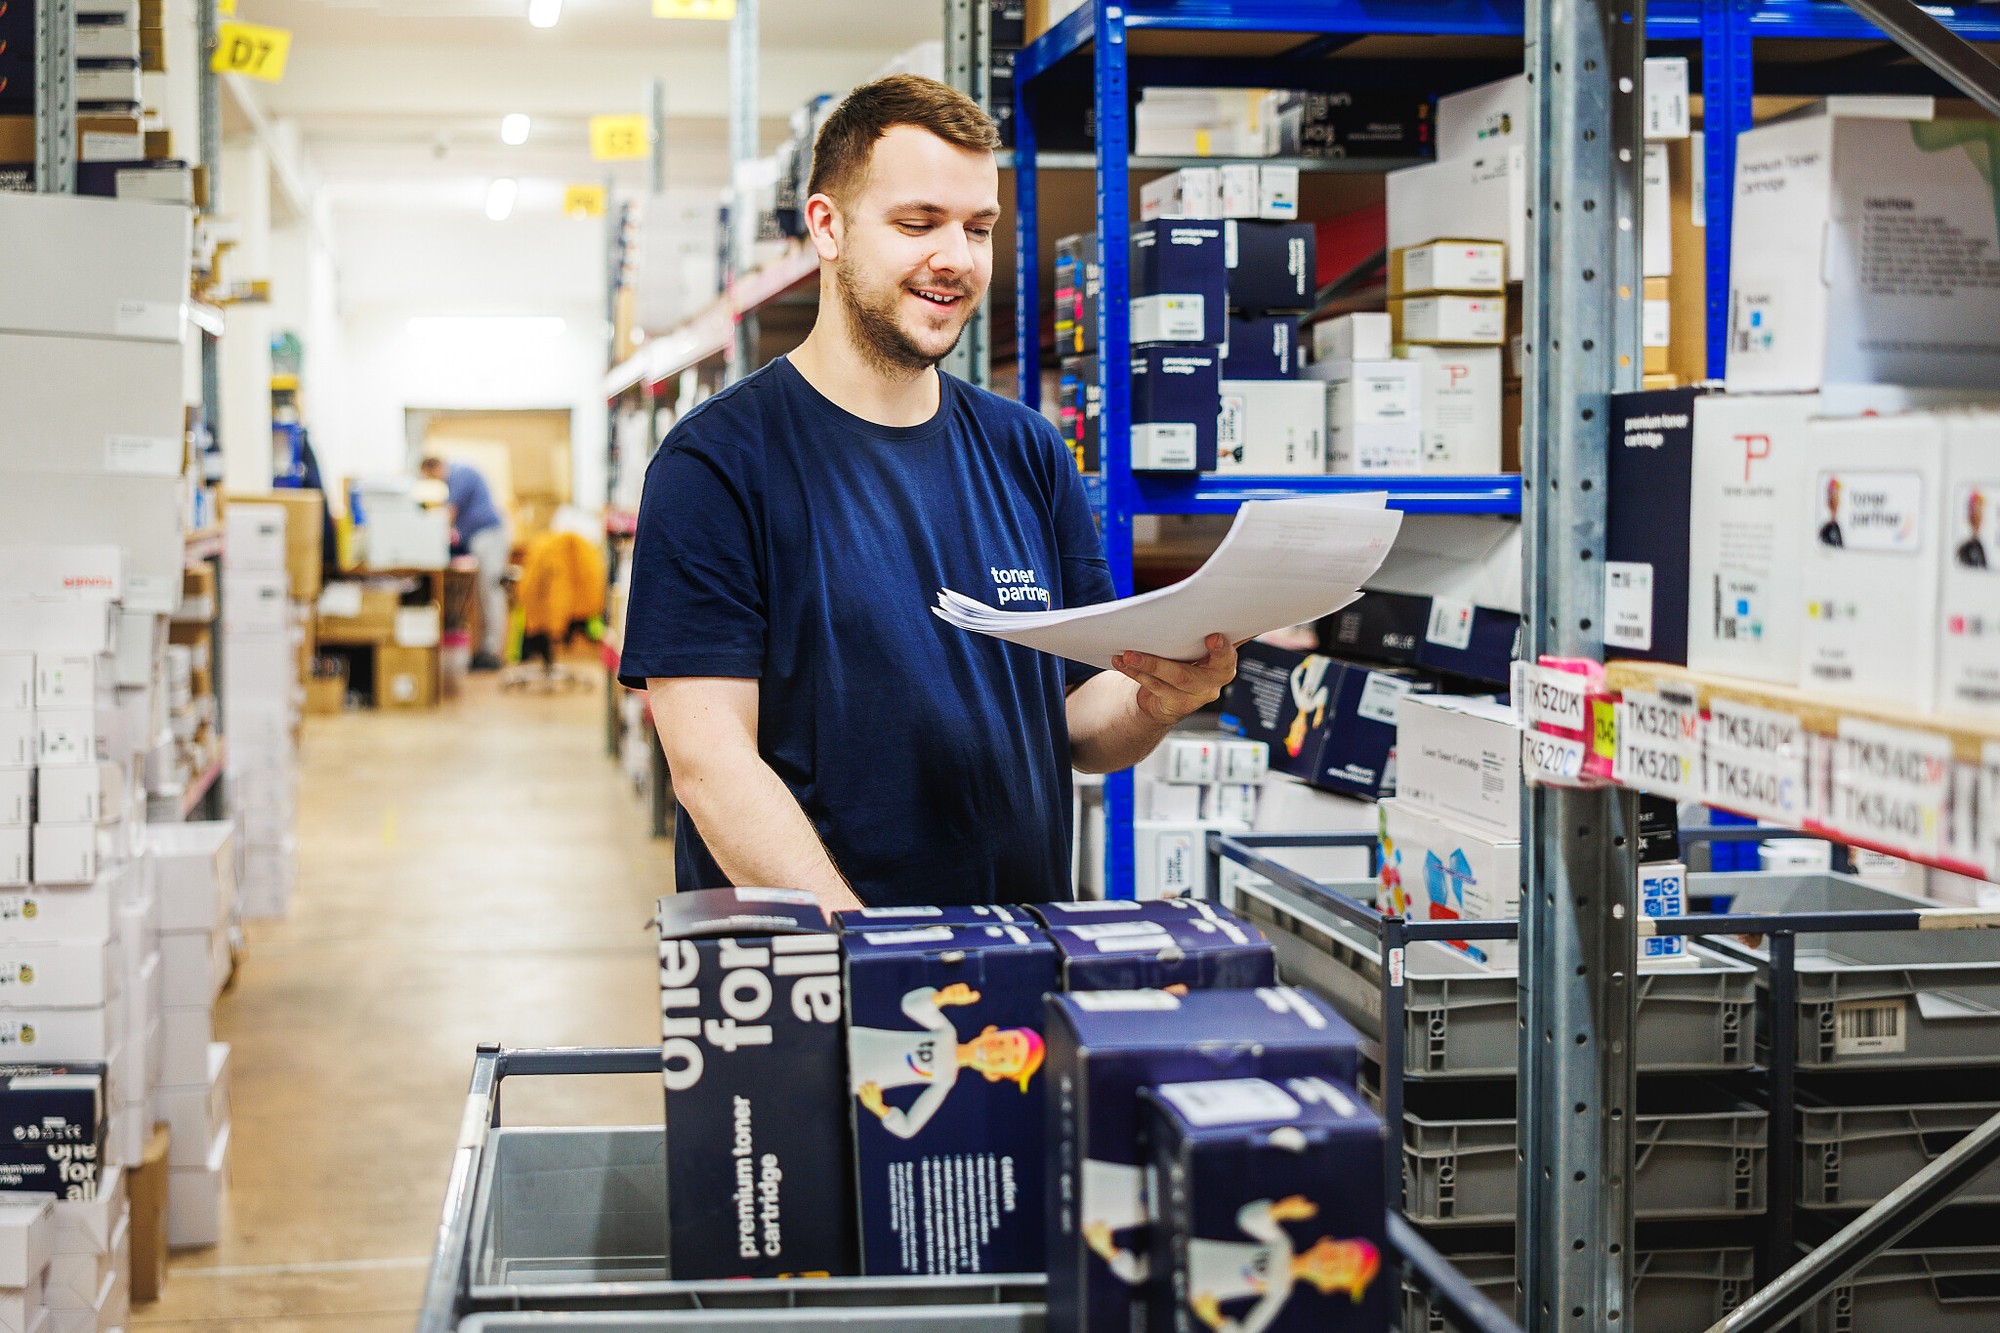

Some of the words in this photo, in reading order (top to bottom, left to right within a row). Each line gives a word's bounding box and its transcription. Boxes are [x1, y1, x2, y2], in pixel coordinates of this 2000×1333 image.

[230, 37, 274, 69] D7
[990, 566, 1036, 584] toner
[997, 584, 1049, 606] partner
[1527, 679, 1582, 719] TK520K
[1627, 701, 1697, 742] TK520M
[1524, 736, 1577, 778] TK520C
[1628, 746, 1692, 785] TK520Y
[1716, 761, 1794, 811] TK540C
[704, 937, 774, 1052] for
[771, 933, 842, 1024] all
[660, 939, 705, 1091] one
[732, 1095, 754, 1158] toner
[58, 1159, 97, 1183] for
[1001, 1156, 1017, 1211] caution
[733, 1157, 761, 1259] premium
[758, 1152, 783, 1259] cartridge
